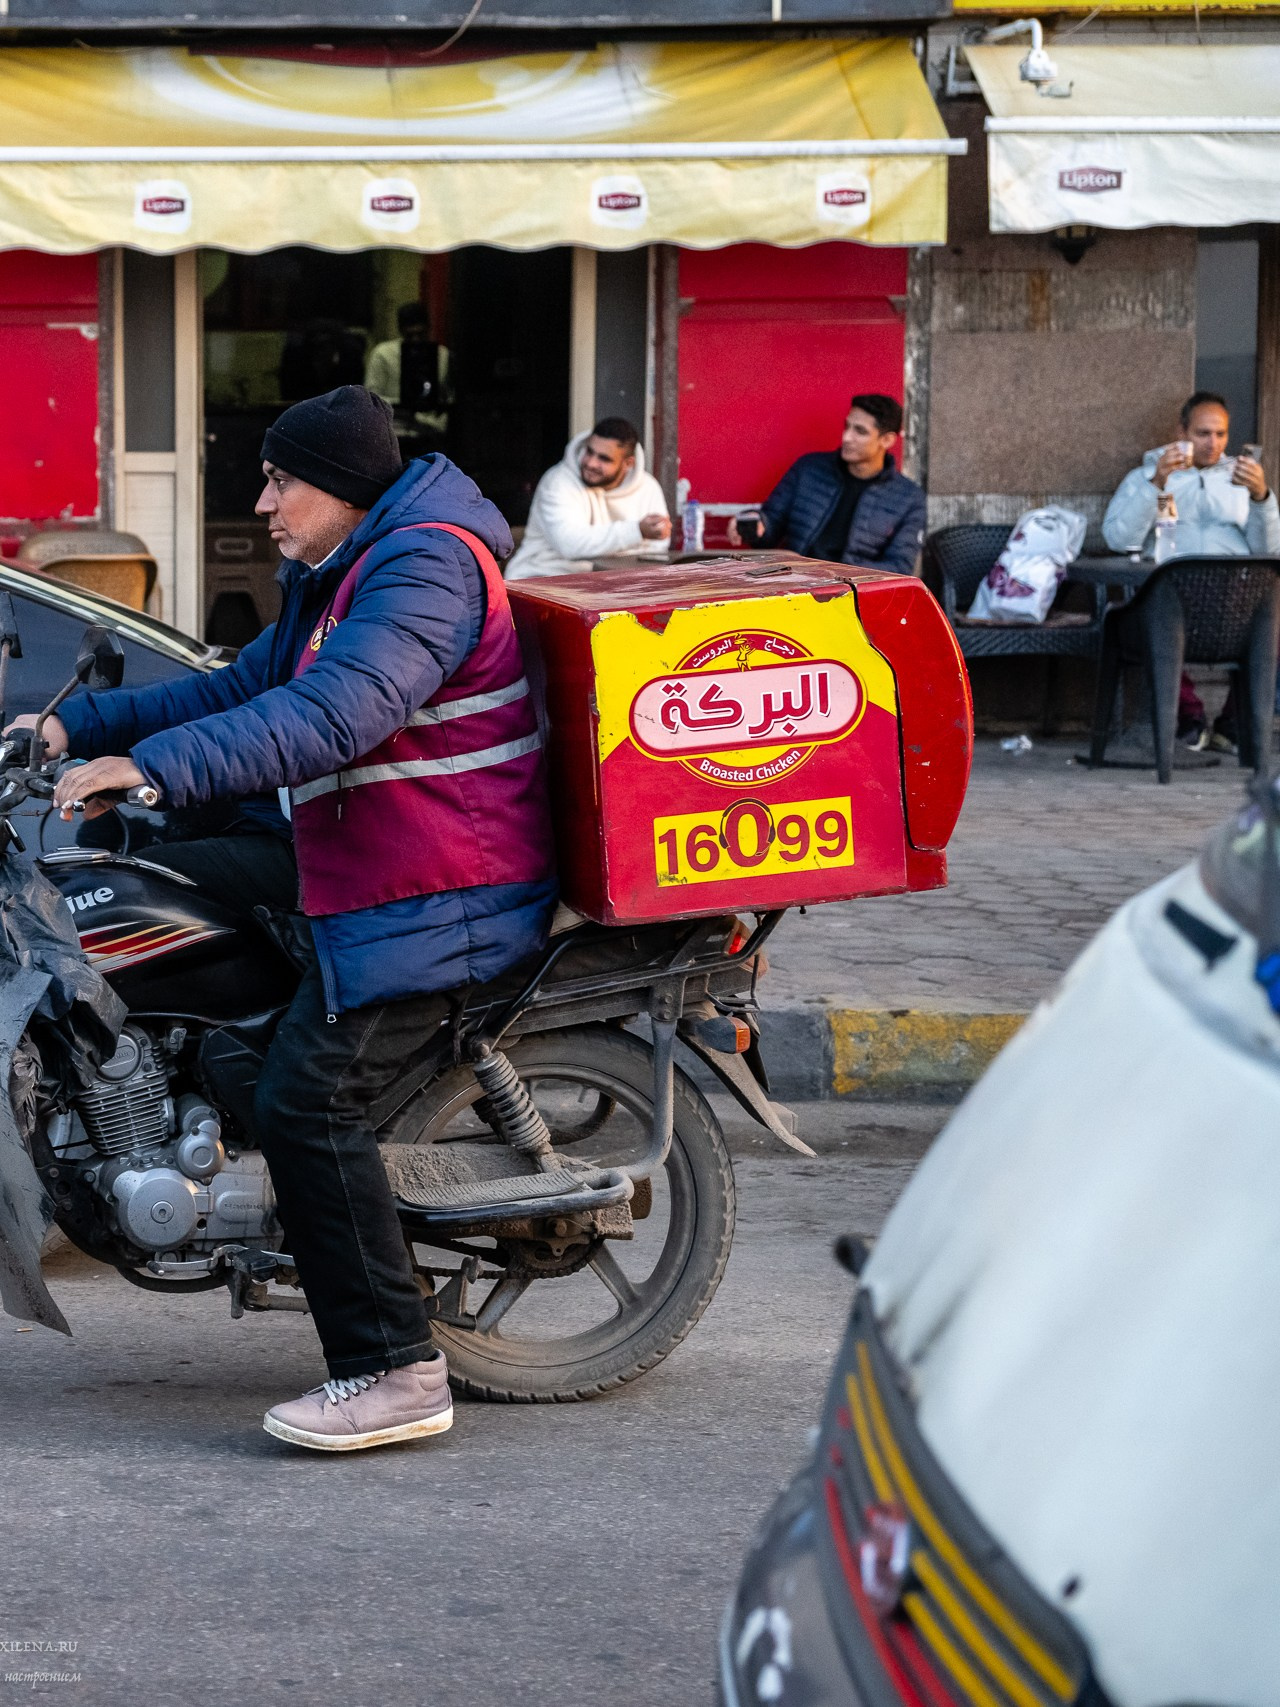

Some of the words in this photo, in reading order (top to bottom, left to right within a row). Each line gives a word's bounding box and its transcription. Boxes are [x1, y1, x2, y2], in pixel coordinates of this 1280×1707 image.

[1062, 171, 1118, 189] Lipton
[144, 198, 182, 211] Lipton
[372, 196, 410, 210] Lipton
[600, 194, 638, 208] Lipton
[825, 191, 863, 204] Lipton
[692, 639, 732, 668] البروست
[764, 638, 795, 656] دجاج
[659, 671, 831, 737] البركة
[700, 759, 754, 781] Broasted
[755, 750, 801, 779] Chicken
[658, 803, 849, 875] 16099
